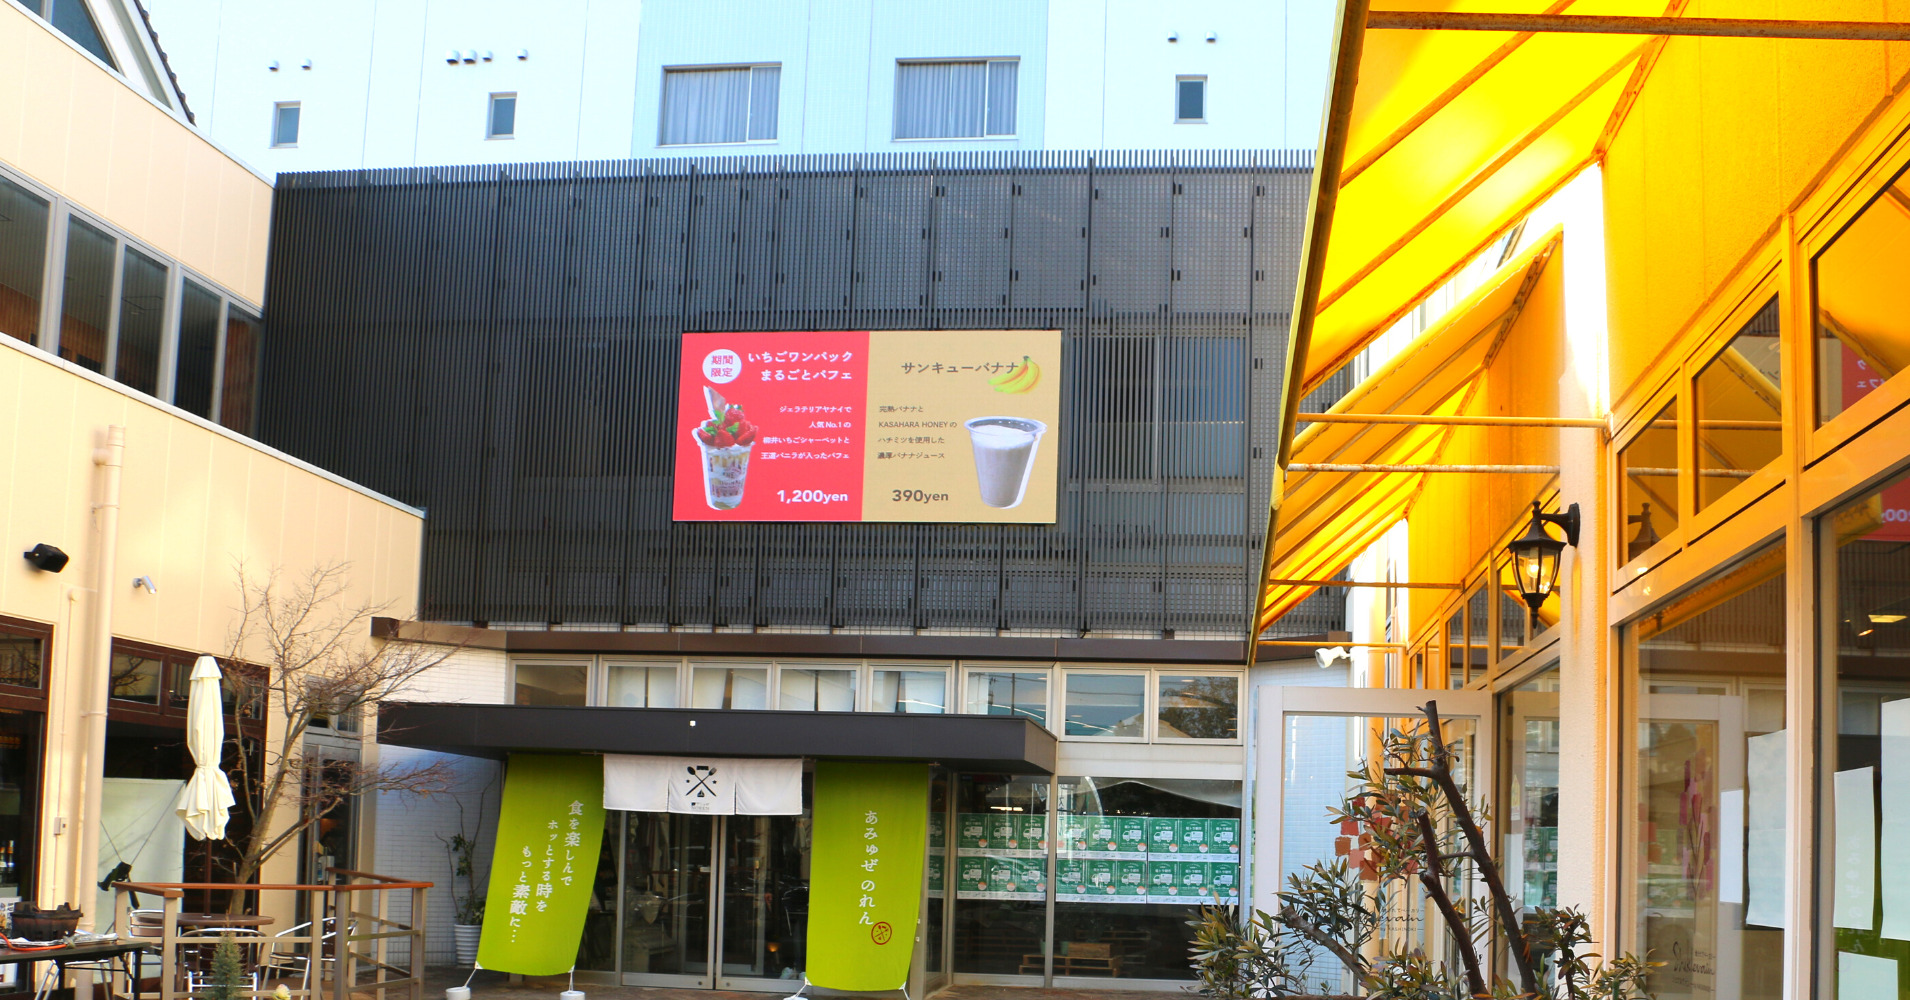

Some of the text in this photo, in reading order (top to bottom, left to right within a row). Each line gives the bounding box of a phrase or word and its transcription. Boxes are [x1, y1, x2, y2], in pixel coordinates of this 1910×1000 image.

[711, 355, 733, 365] 期間
[747, 351, 853, 363] いちごワンパック
[710, 367, 733, 378] 限定
[901, 361, 1019, 374] サンキューバナナ
[760, 369, 853, 381] まるごとパフェ
[879, 405, 924, 413] 完熟バナナと
[877, 436, 945, 444] ハチミツを使用した
[877, 452, 945, 460] 濃厚バナナジュース
[776, 489, 849, 505] 1,200yen
[891, 489, 949, 504] 390yen
[560, 800, 584, 886] 食を楽しんで
[535, 819, 559, 912] ホッとする時を
